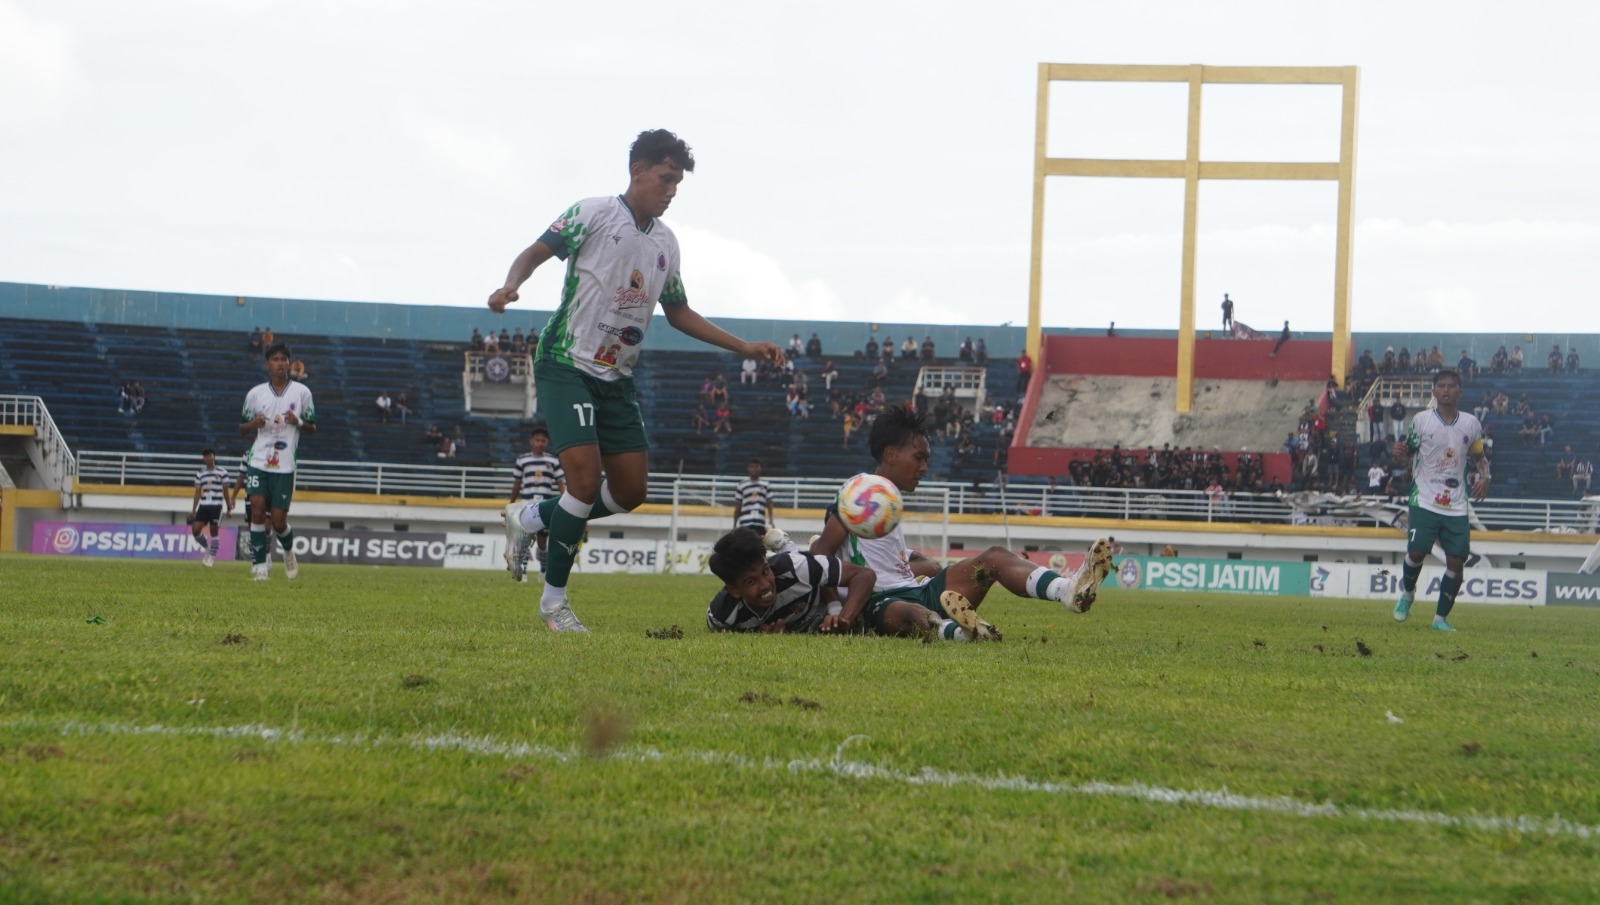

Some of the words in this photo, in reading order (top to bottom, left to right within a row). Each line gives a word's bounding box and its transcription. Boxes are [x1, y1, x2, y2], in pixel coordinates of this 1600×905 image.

[573, 402, 594, 427] 17
[247, 475, 260, 488] 26
[81, 530, 207, 553] PSSIJATIM
[588, 549, 656, 566] STORE
[1145, 561, 1206, 588] PSSI
[1207, 563, 1280, 591] JATIM
[1425, 576, 1538, 599] ACESS
[1555, 585, 1600, 600] ww
